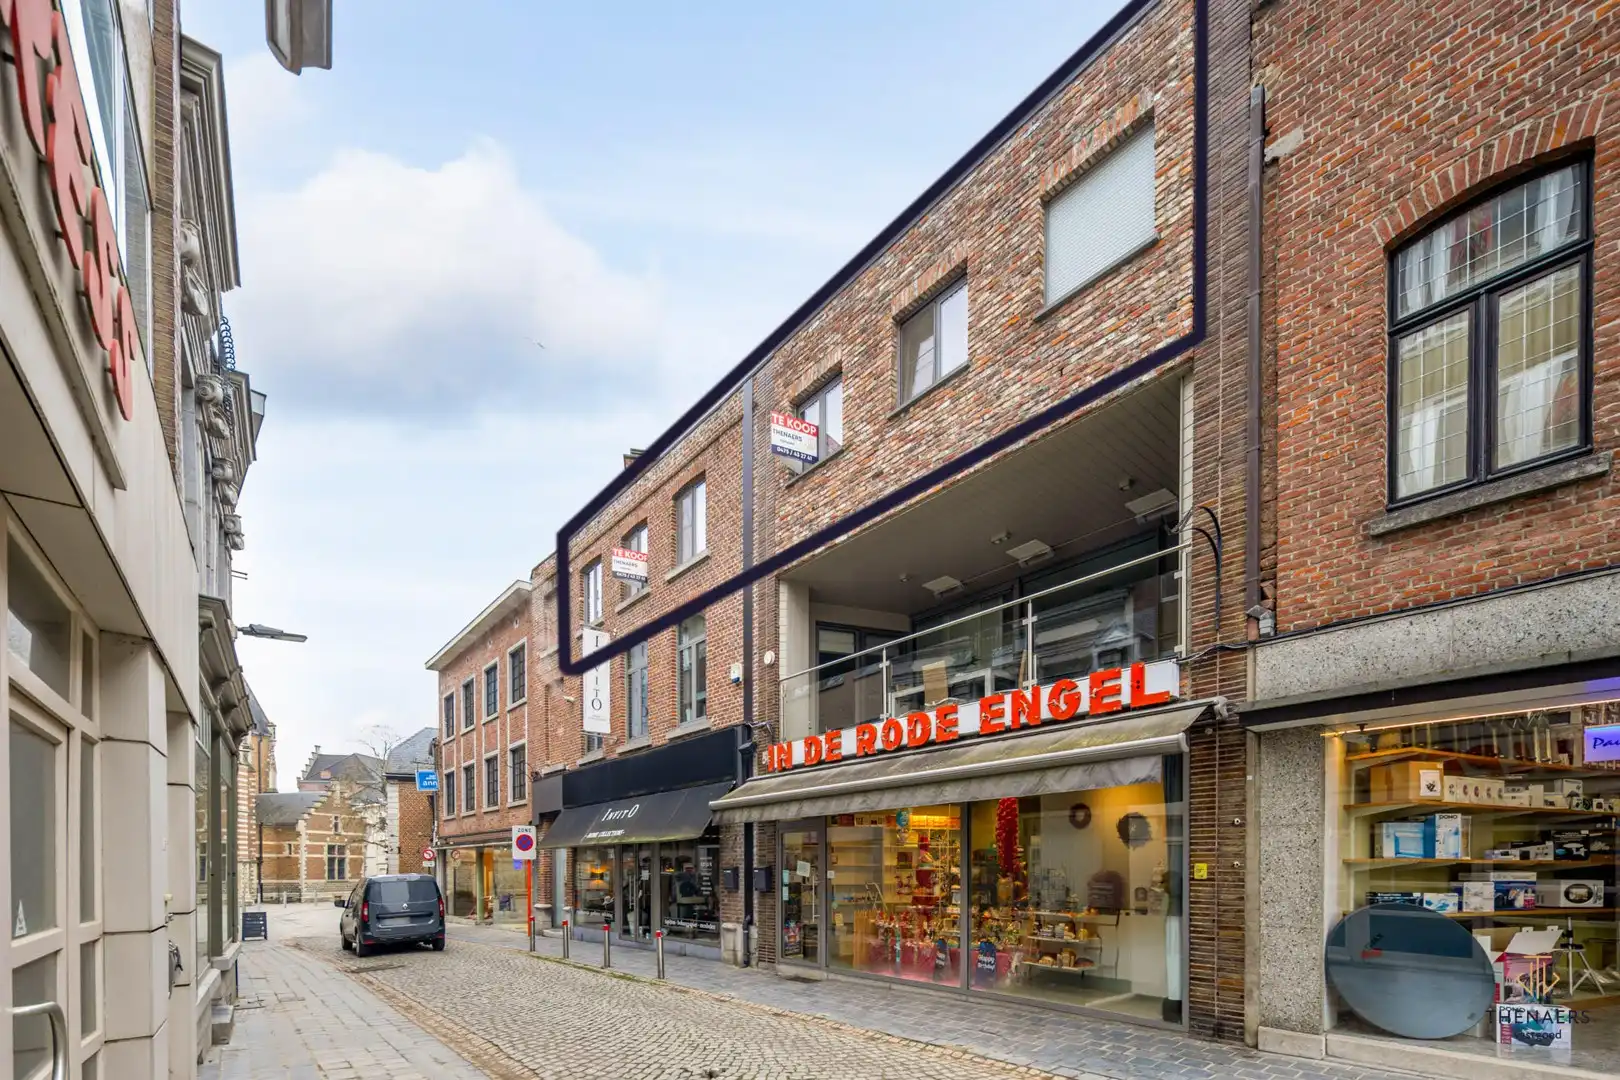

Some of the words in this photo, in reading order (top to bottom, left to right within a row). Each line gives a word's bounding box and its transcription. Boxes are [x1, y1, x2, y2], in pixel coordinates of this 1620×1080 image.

[772, 413, 785, 425] TE
[786, 416, 817, 435] KOOP
[613, 549, 625, 557] TE
[767, 741, 793, 773] IN
[803, 729, 843, 766] DE
[856, 704, 959, 757] RODE
[979, 662, 1171, 735] ENGEL
